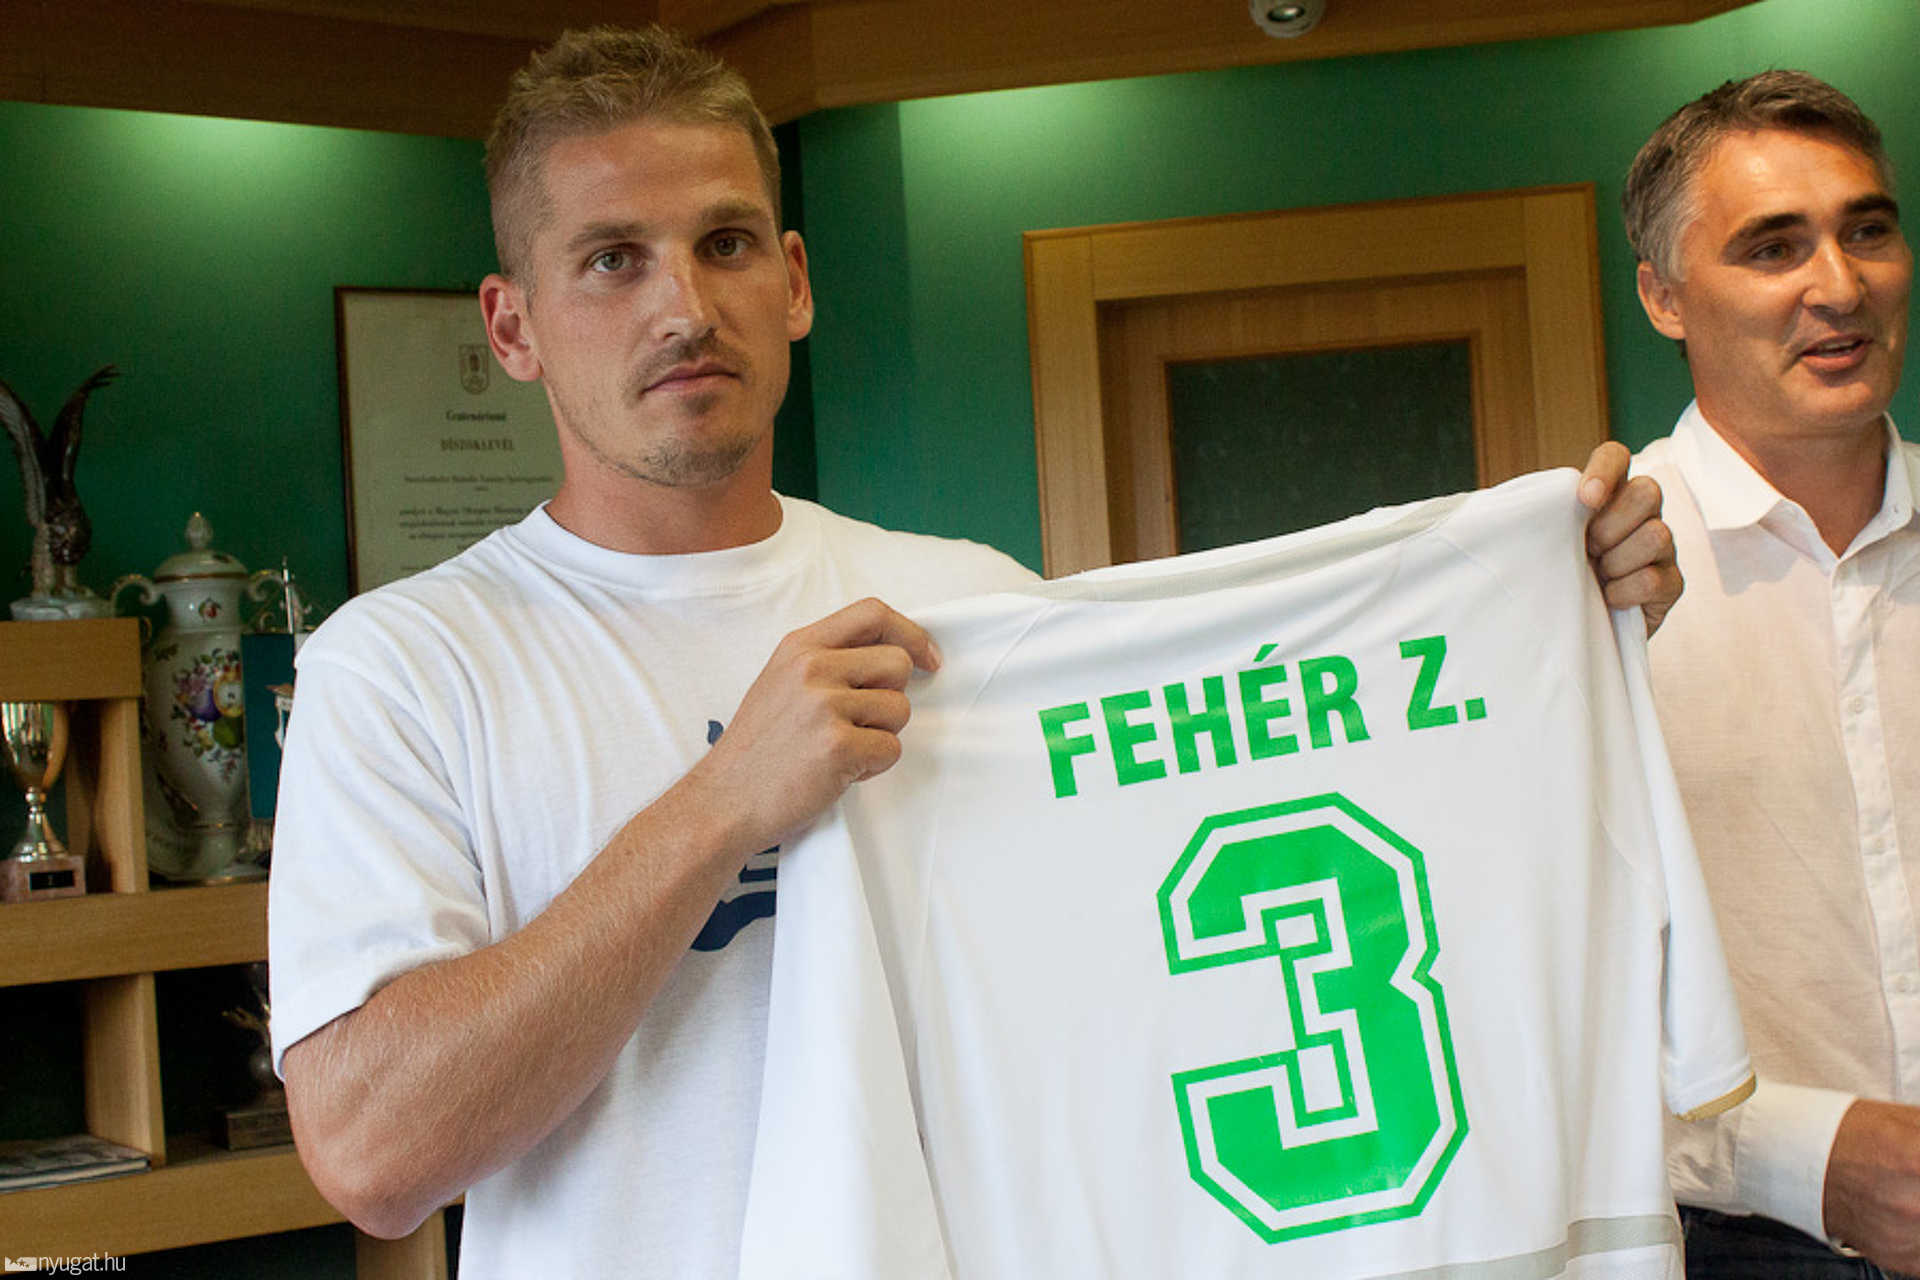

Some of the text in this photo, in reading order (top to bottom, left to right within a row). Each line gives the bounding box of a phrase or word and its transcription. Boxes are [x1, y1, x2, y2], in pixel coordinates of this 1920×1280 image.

[1038, 635, 1487, 798] FEHÉR Z.
[1156, 791, 1470, 1245] 3
